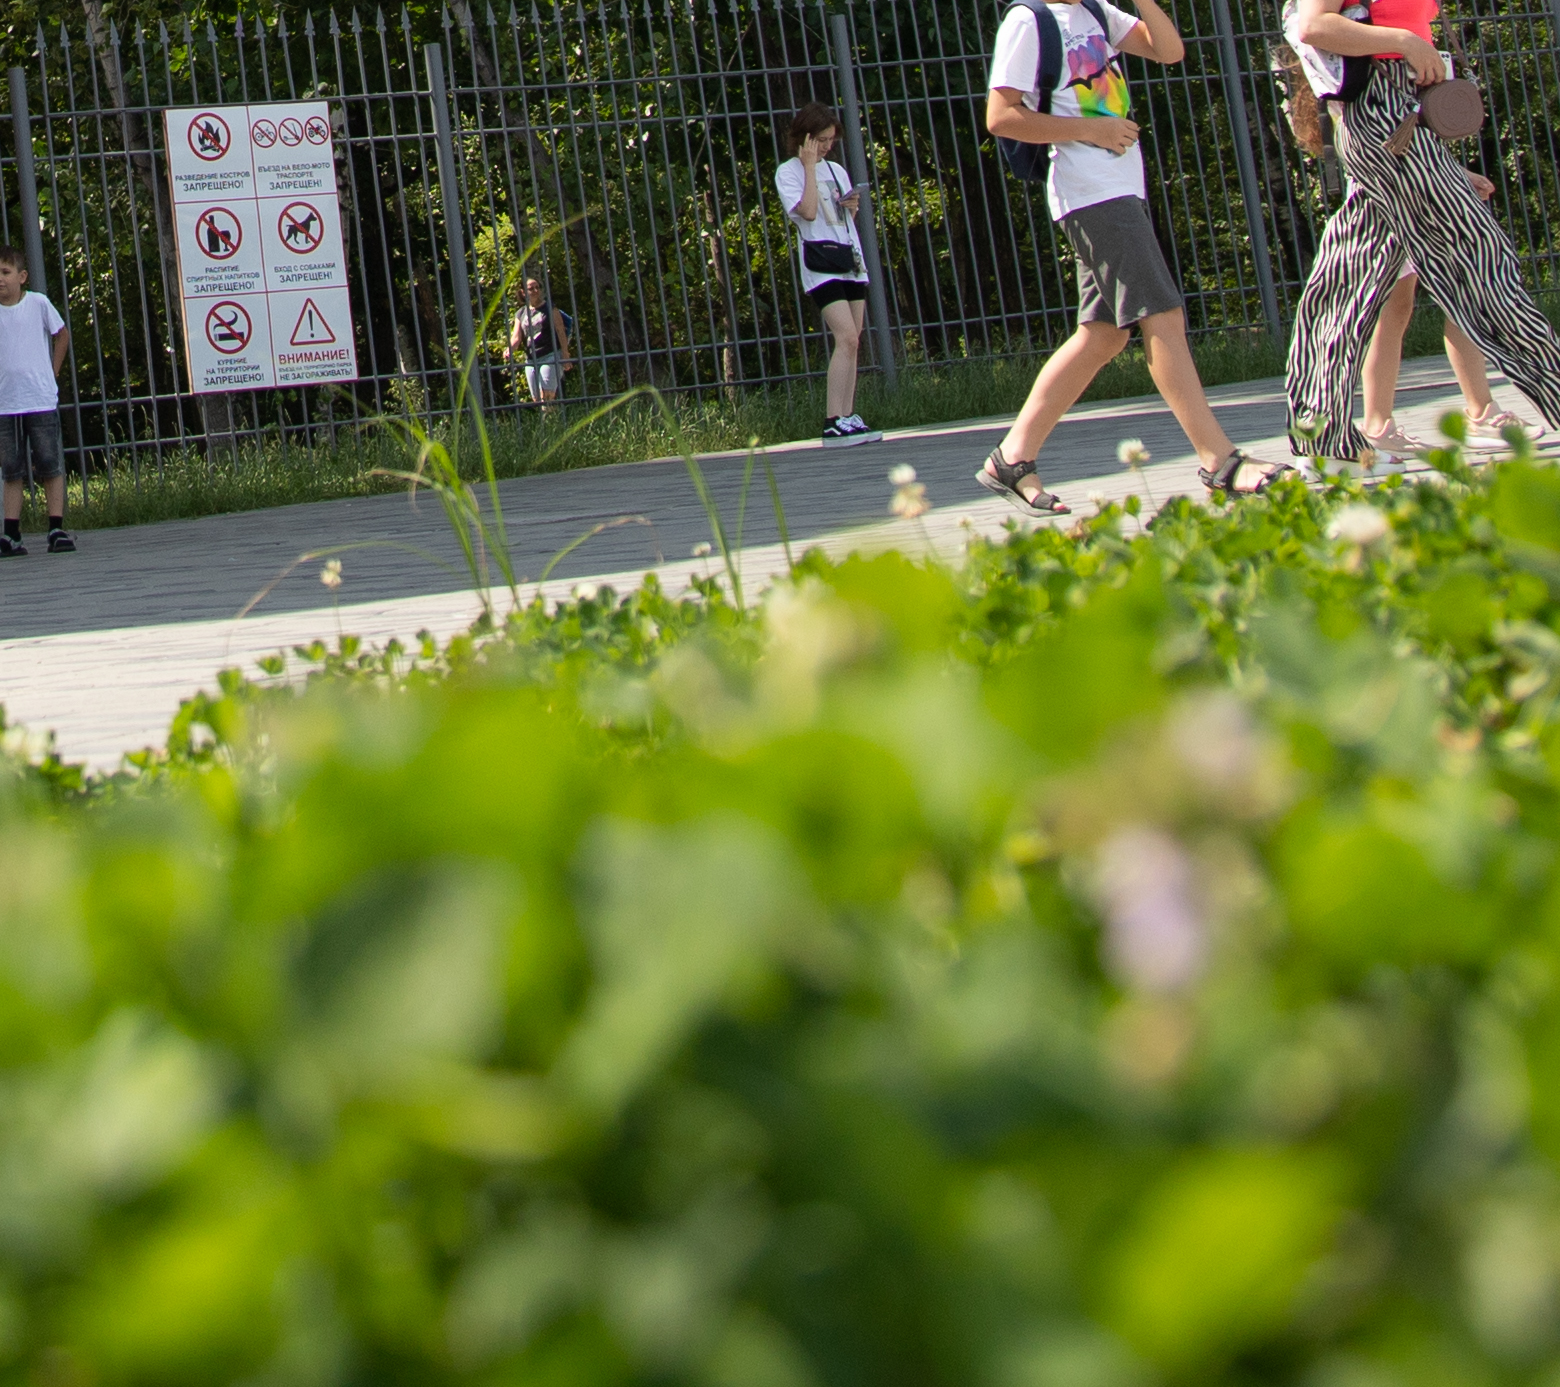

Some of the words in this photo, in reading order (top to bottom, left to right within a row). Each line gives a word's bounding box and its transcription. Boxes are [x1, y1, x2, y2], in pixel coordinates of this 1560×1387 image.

[258, 165, 280, 173] ВЪЕЗД
[292, 162, 330, 171] ВЕЛО-МОТО
[175, 172, 218, 181] РАЗВЕДЕНИЕ
[220, 171, 250, 179] КОСТРОВ
[276, 171, 314, 179] ТРАСПОРТЕ
[183, 180, 244, 192] ЗАПРЕЩЕНО!
[269, 179, 323, 190] ЗАПРЕЩЕН!
[205, 265, 239, 274] РАСПИТИЕ
[300, 262, 336, 270] СОБАКАМИ
[186, 274, 223, 283] СПИРТНЫХ
[225, 272, 260, 280] НАПИТКОВ
[279, 271, 333, 283] ЗАПРЕЩЕН!
[194, 281, 255, 293] ЗАПРЕЩЕНО!
[217, 357, 247, 365] КУРЕНИЕ
[279, 349, 350, 365] ВНИМАНИЕ!
[206, 367, 216, 375] НА
[217, 365, 260, 374] ТЕРРИТОРИИ
[280, 373, 290, 381] НЕ
[291, 369, 353, 380] ЗАГОРАЖИВАТЬ!
[204, 373, 264, 386] ЗАПРЕЩЕНО!
